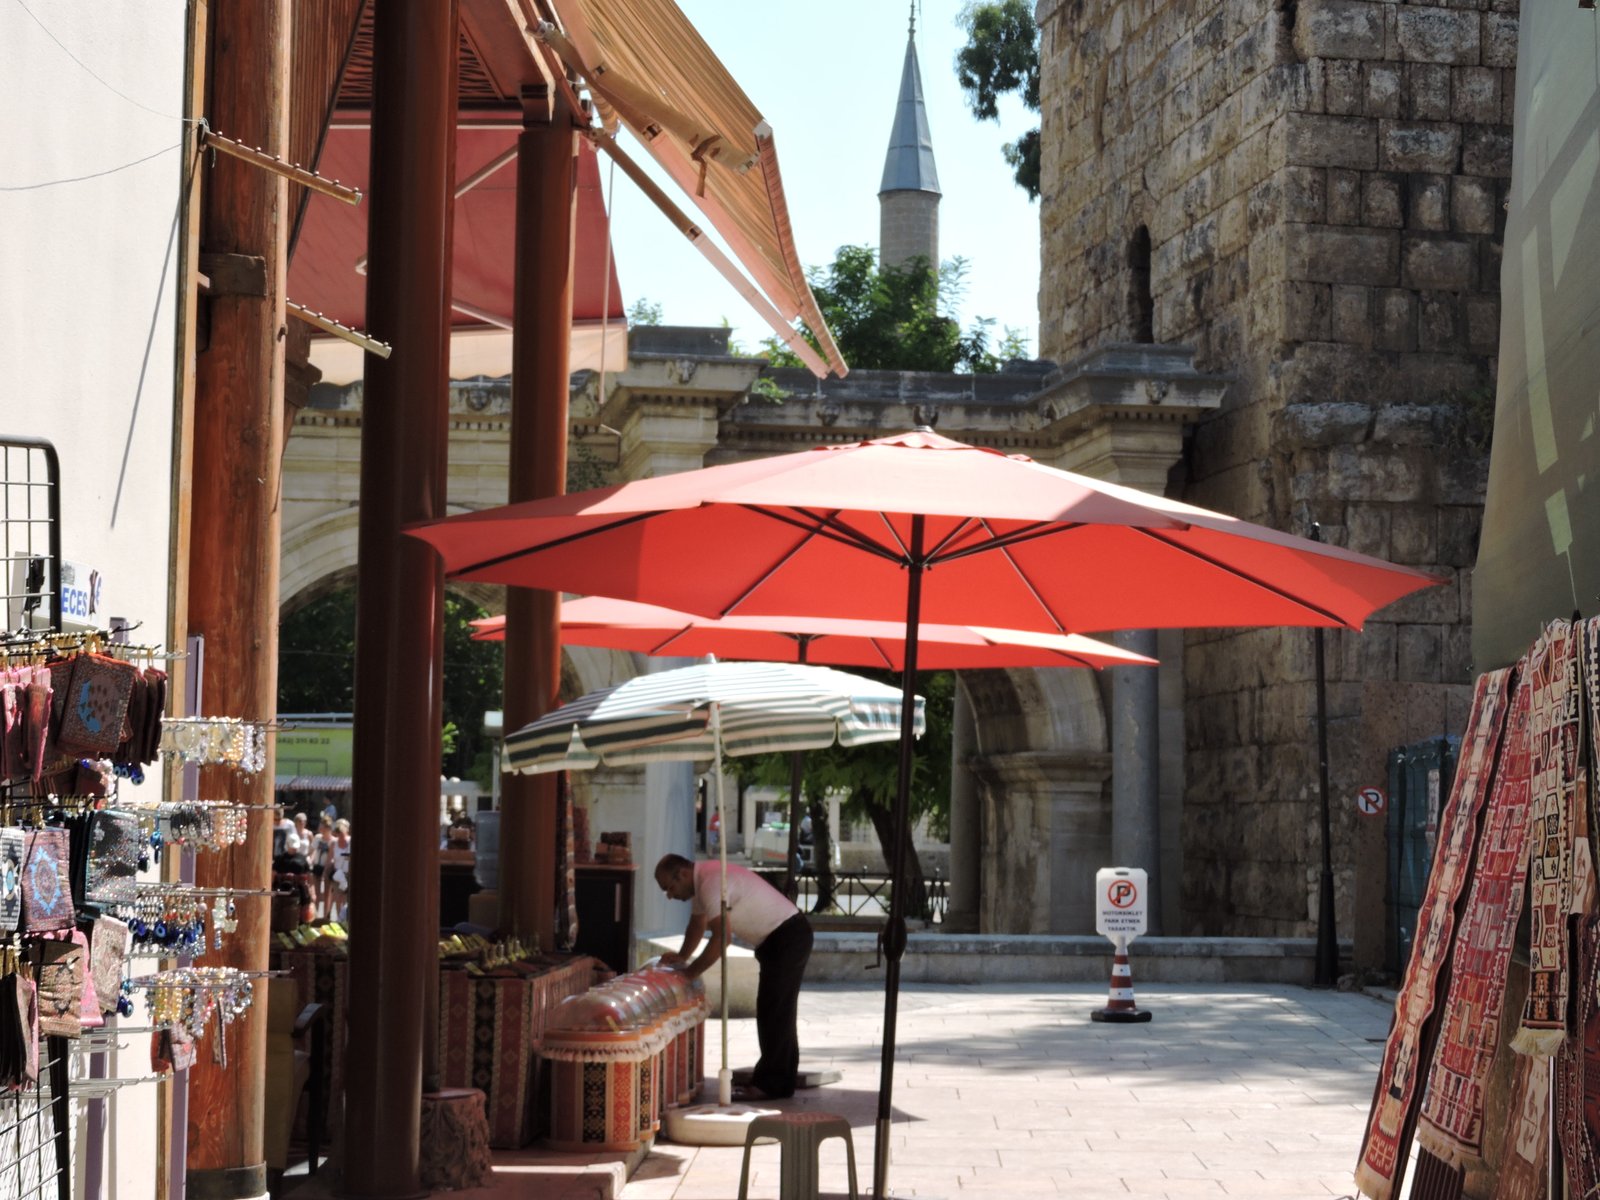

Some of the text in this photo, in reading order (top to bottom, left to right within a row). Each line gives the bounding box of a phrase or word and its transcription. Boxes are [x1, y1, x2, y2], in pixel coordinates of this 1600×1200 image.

[62, 586, 87, 617] ECES
[1365, 792, 1380, 811] P
[1116, 885, 1131, 904] P
